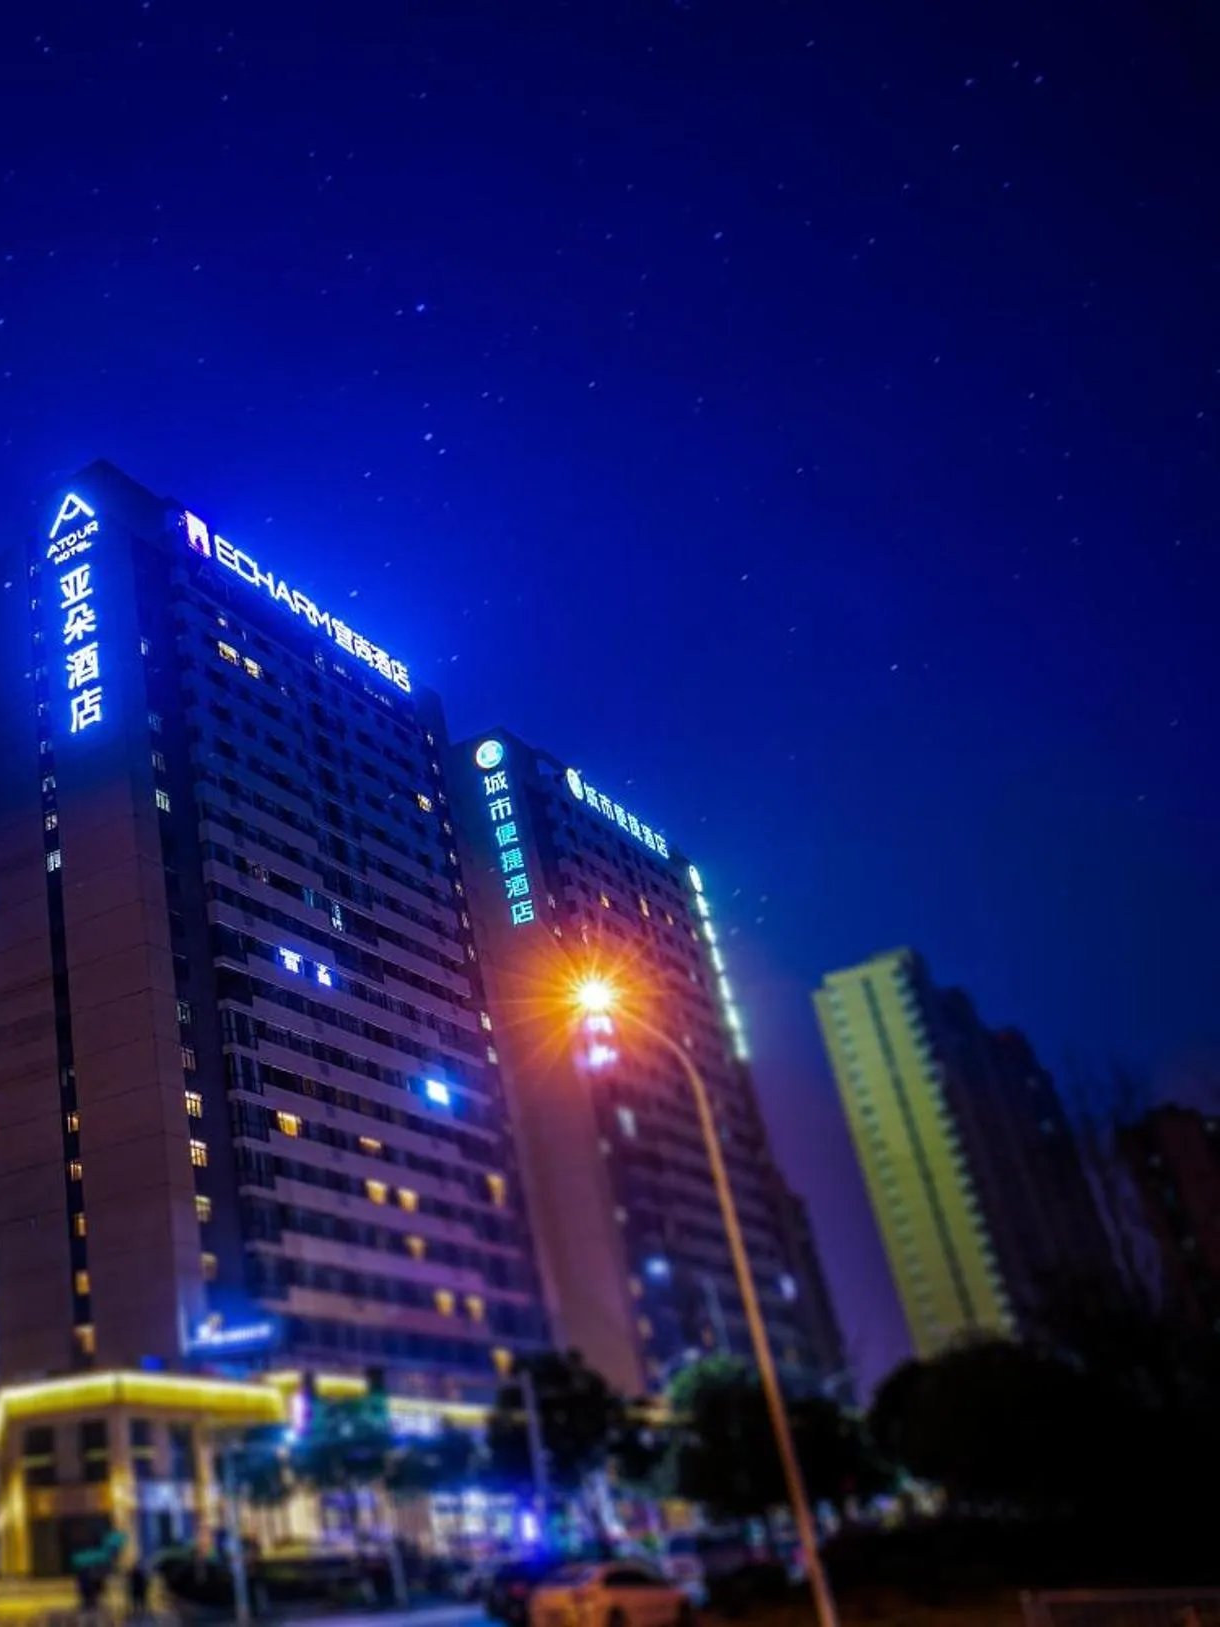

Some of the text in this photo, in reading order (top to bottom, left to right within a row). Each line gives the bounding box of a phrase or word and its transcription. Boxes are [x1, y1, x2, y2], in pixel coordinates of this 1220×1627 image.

[46, 520, 99, 558] ATOUR
[214, 534, 332, 637] ECHARM
[59, 563, 103, 733] 亚朵酒店
[484, 771, 535, 926] 城市便捷酒店
